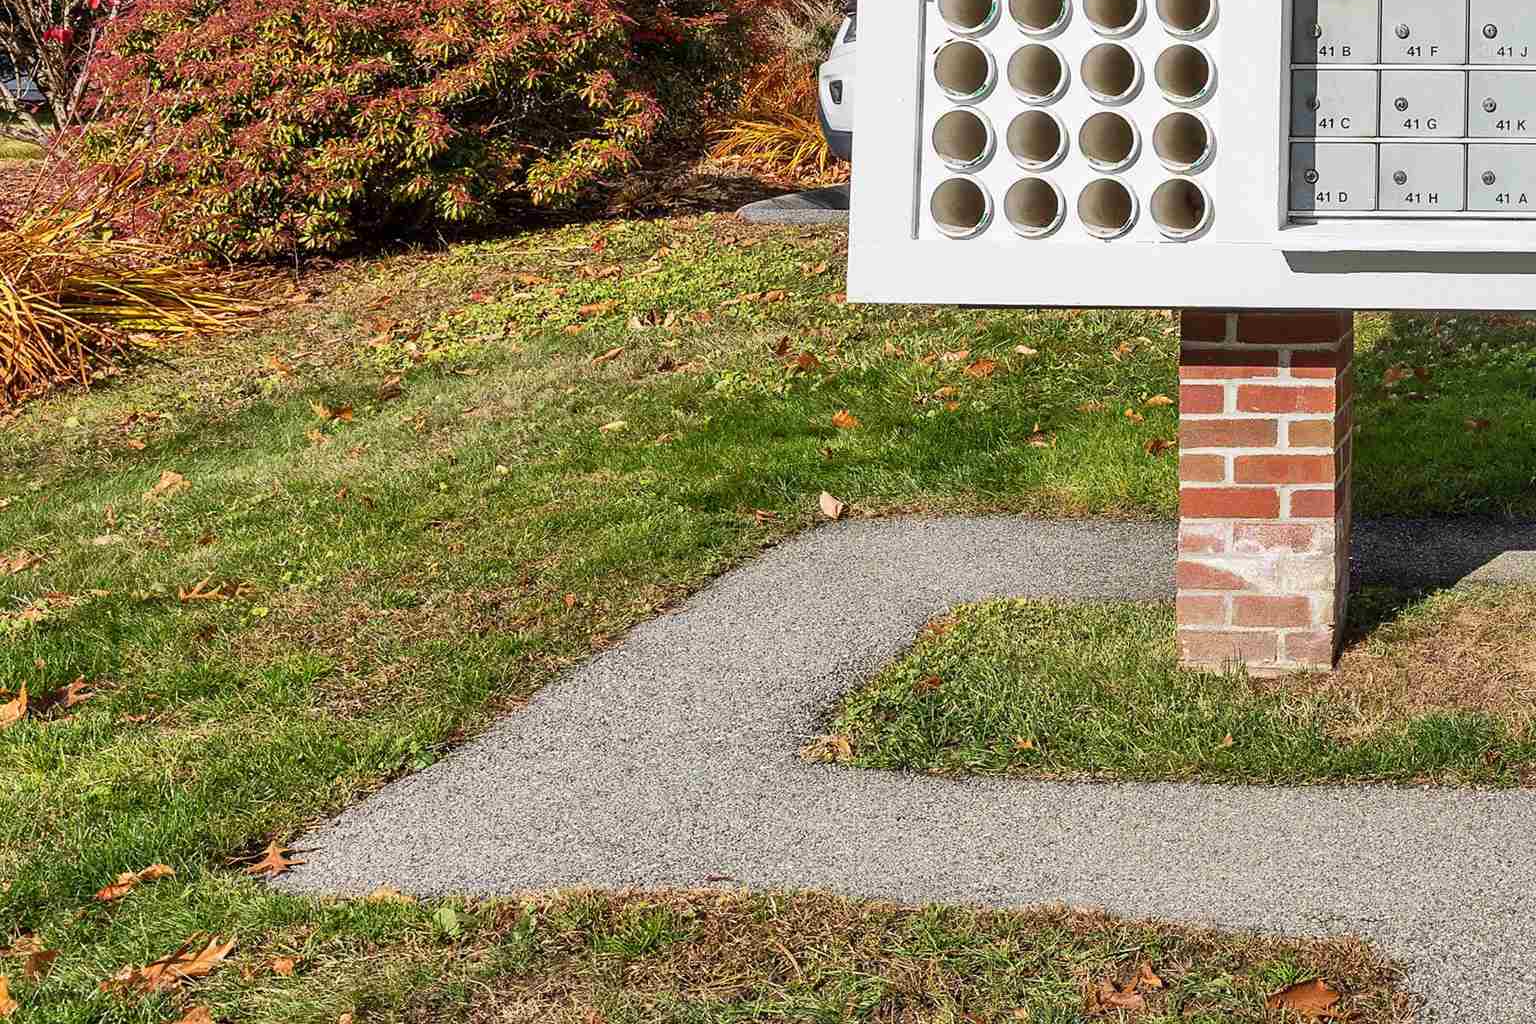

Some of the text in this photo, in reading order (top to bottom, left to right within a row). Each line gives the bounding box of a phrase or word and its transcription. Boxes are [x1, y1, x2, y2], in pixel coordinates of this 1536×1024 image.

[1318, 45, 1352, 57] 41 B
[1406, 45, 1439, 57] 41 F
[1496, 46, 1528, 58] 41 J
[1318, 117, 1351, 130] 41 C
[1403, 117, 1437, 130] 41 G
[1495, 119, 1527, 131] 41 K
[1316, 191, 1348, 203] 41 D
[1404, 192, 1439, 204] 41 H
[1495, 192, 1528, 205] 41 A
